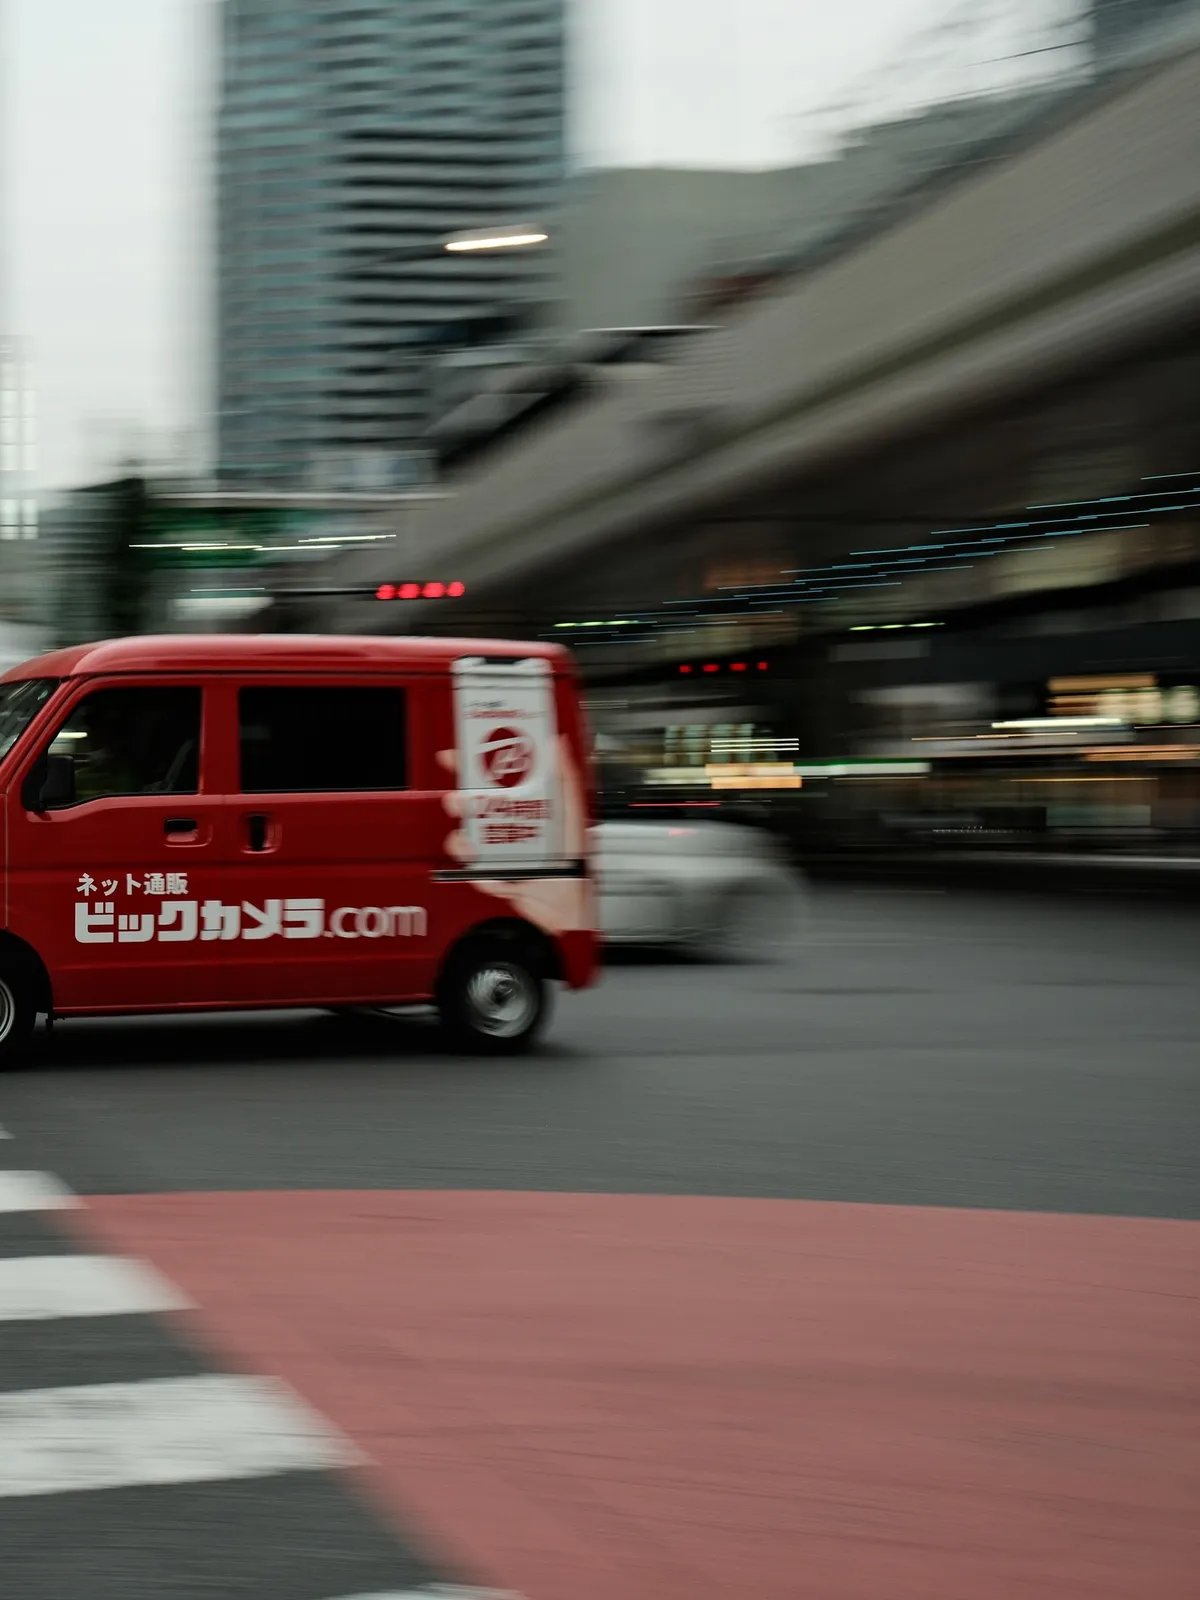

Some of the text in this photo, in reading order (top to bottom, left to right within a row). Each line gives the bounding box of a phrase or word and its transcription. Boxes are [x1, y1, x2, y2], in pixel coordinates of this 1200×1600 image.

[76, 872, 189, 896] ネット通販
[75, 898, 428, 944] ビックカメラ.com
